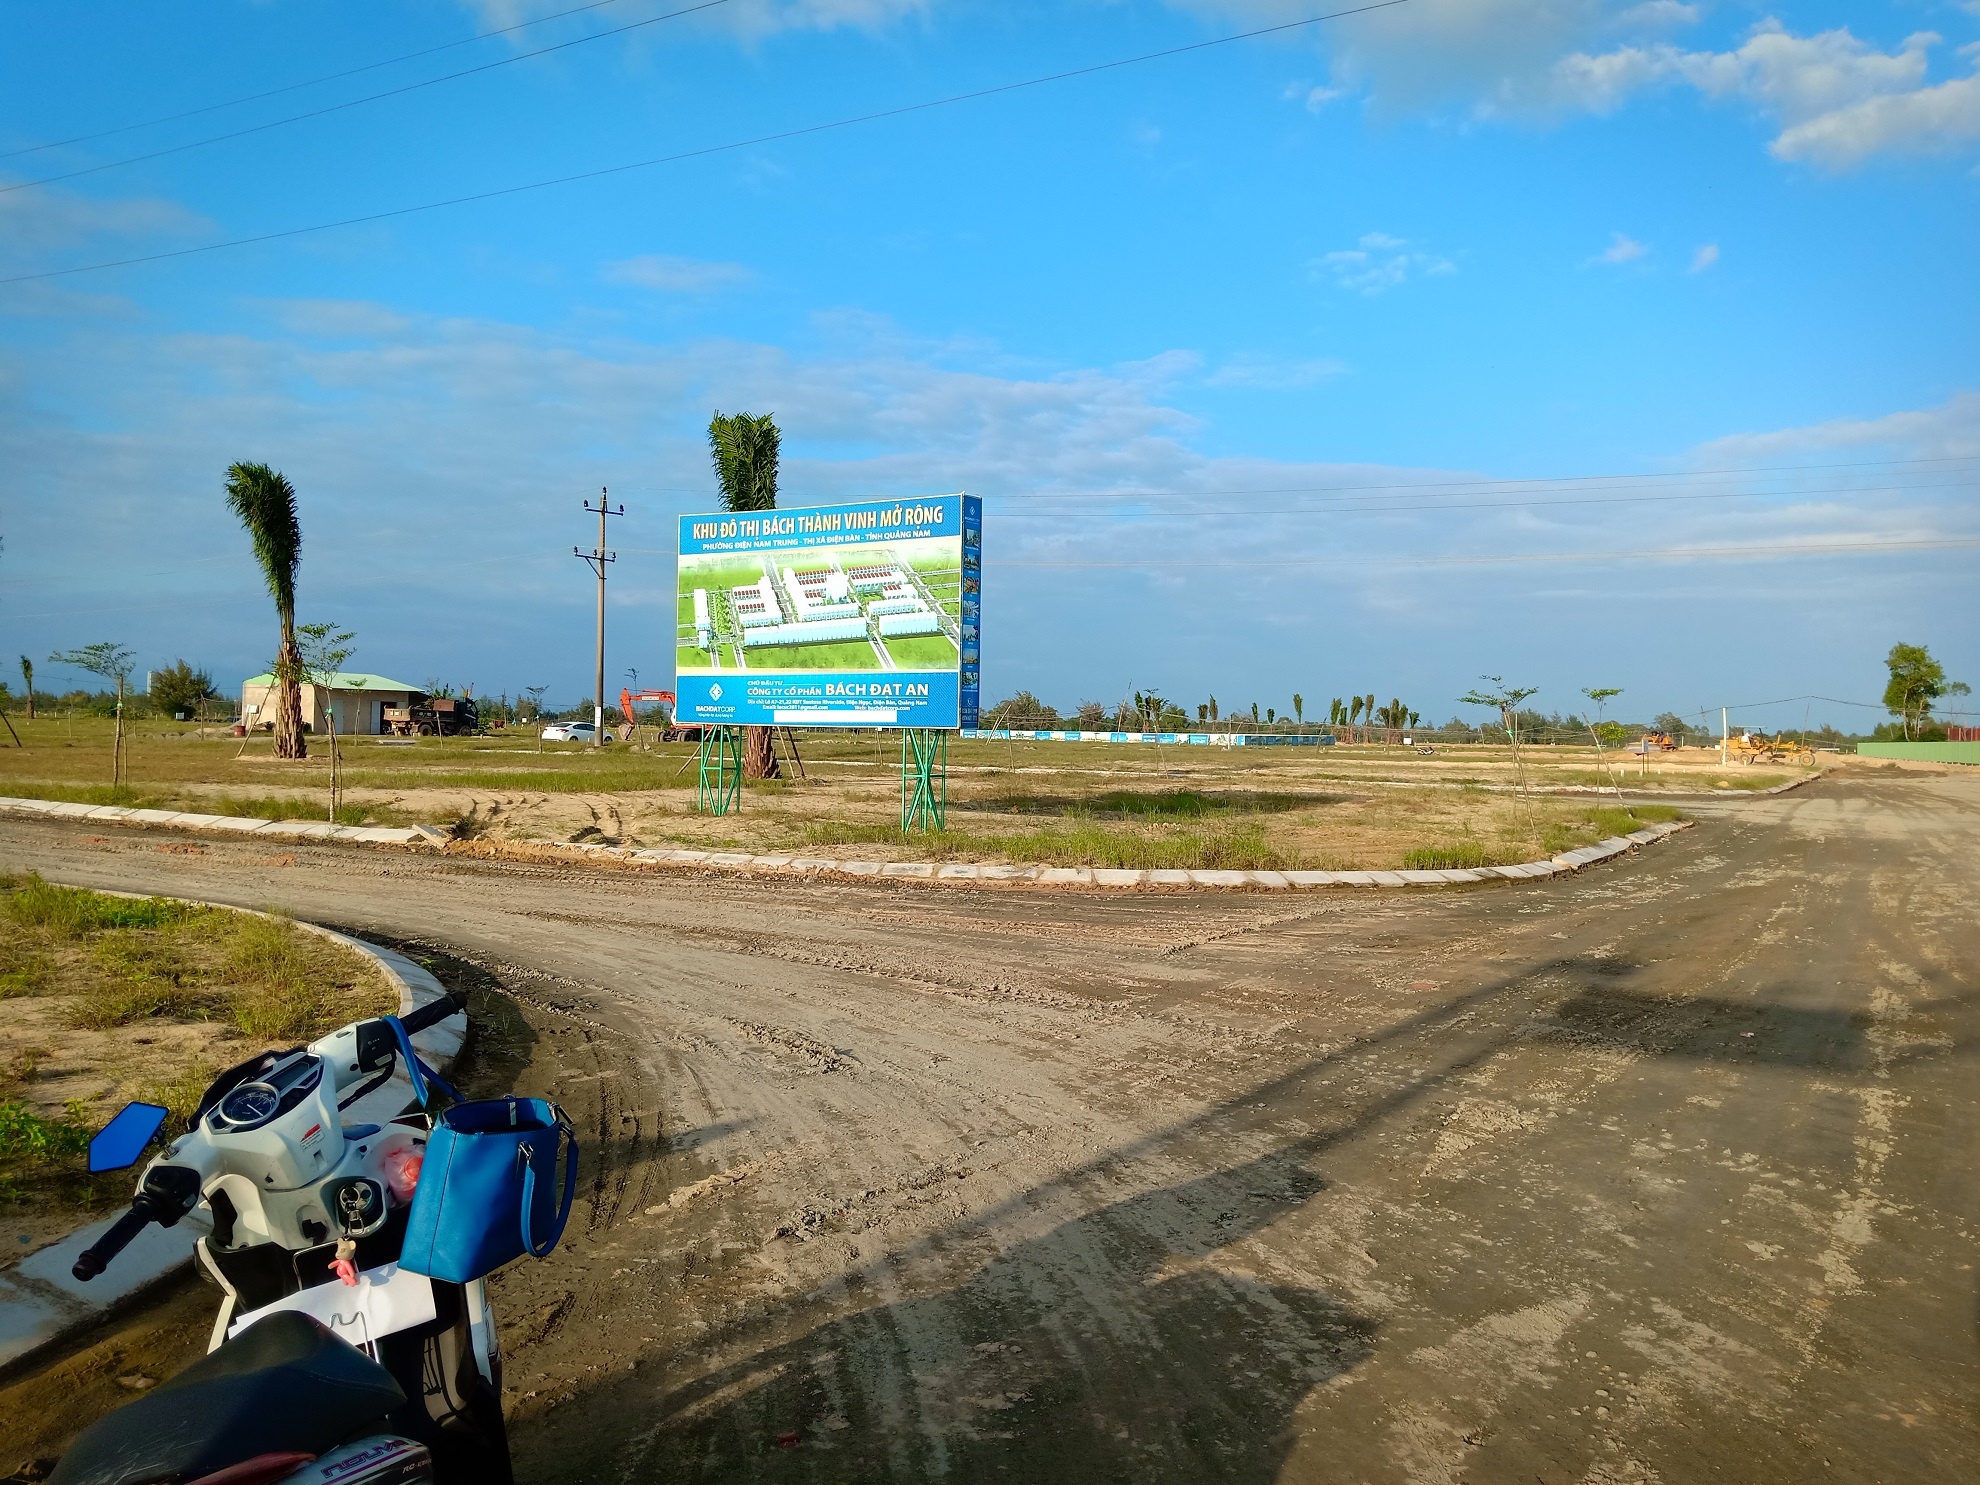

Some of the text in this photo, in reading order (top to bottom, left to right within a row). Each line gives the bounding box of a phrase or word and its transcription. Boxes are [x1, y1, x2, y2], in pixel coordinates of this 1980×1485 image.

[693, 504, 943, 541] KHU ĐÔ THỊ BÁCH THÀNH VINH MỞ RỘNG
[702, 541, 733, 550] PHƯỜNG
[734, 540, 752, 549] ĐIỆN
[753, 540, 771, 548] NAM
[773, 538, 798, 546] TRUNG
[803, 537, 815, 546] THỊ
[816, 535, 826, 544] XÃ
[826, 534, 844, 544] ĐIỆN
[845, 534, 860, 542] BÀN
[884, 529, 911, 539] QUẢNG
[912, 529, 931, 537] NAM
[747, 686, 771, 695] CÔNG
[825, 681, 866, 696] BÁCH
[869, 683, 902, 699] ĐẠT
[905, 683, 929, 696] AN
